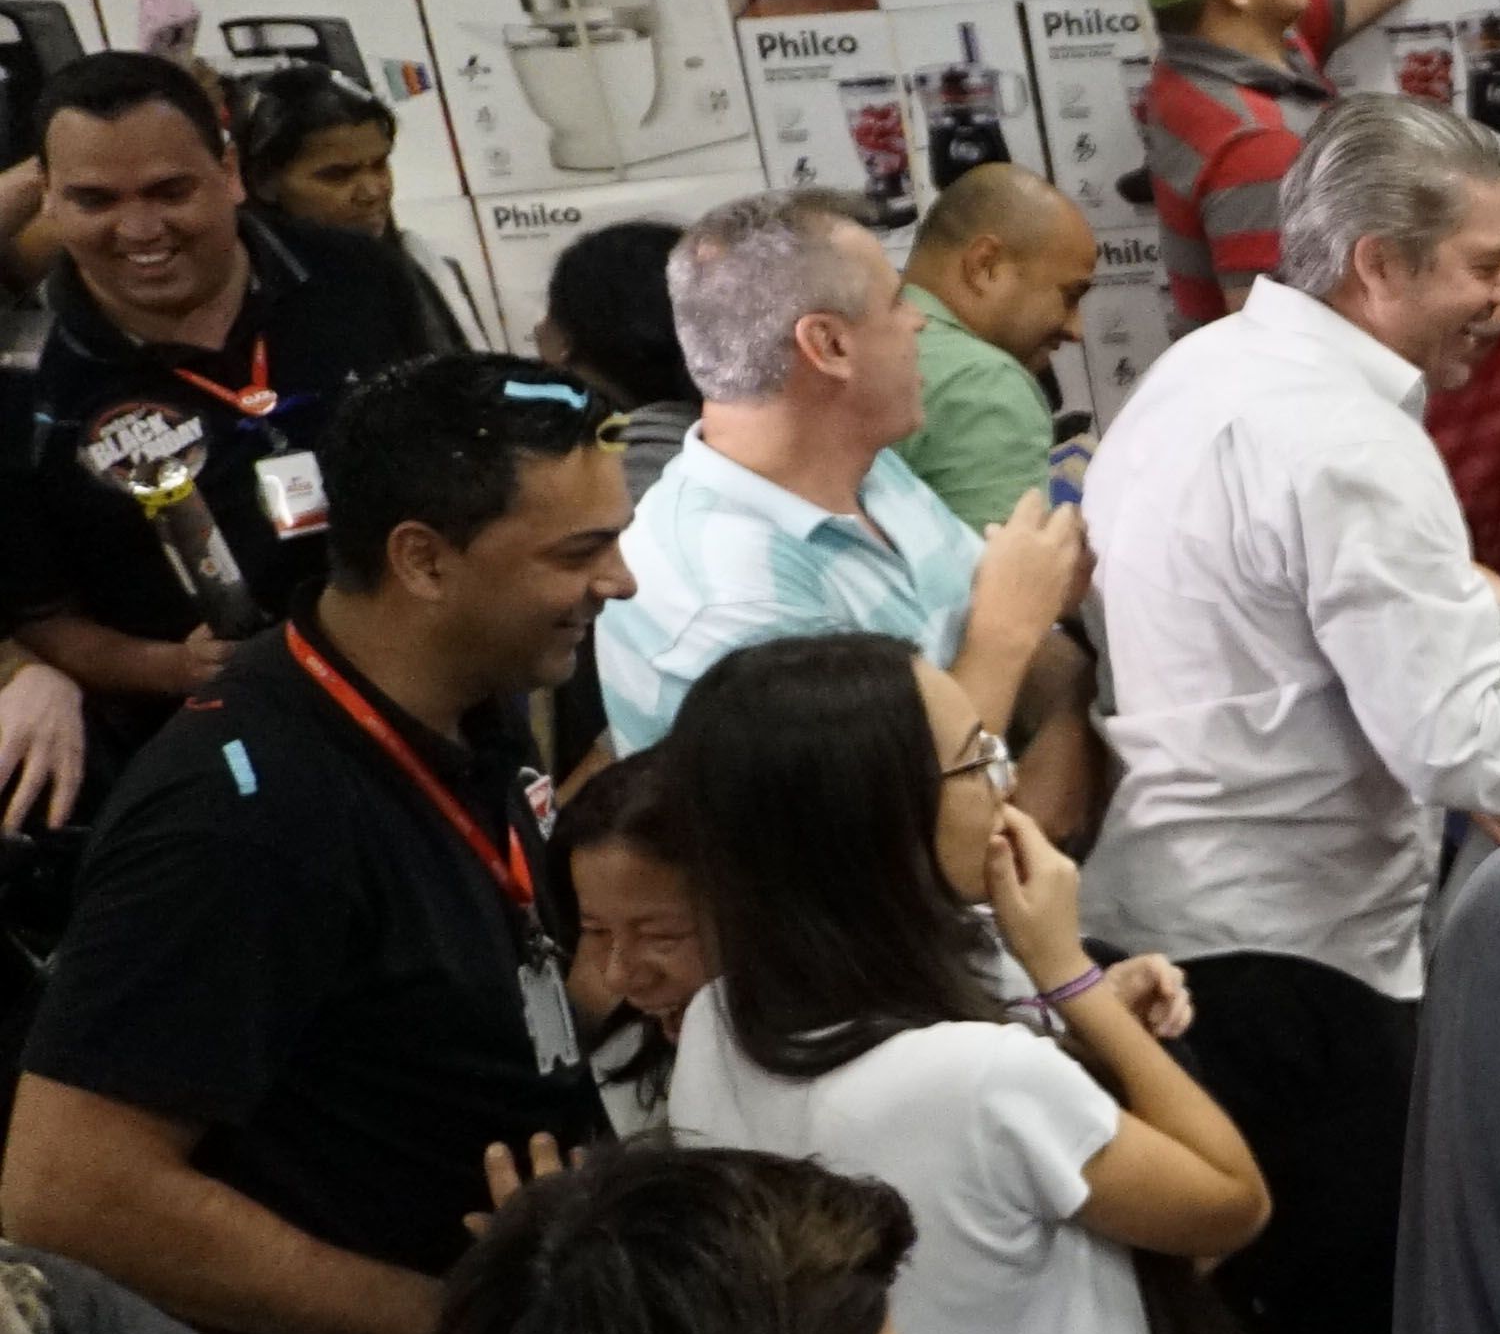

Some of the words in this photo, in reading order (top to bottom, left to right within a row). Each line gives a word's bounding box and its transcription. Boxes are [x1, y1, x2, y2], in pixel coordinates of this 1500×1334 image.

[1043, 9, 1141, 40] Philco
[755, 28, 859, 60] Philco
[493, 202, 583, 234] Philco
